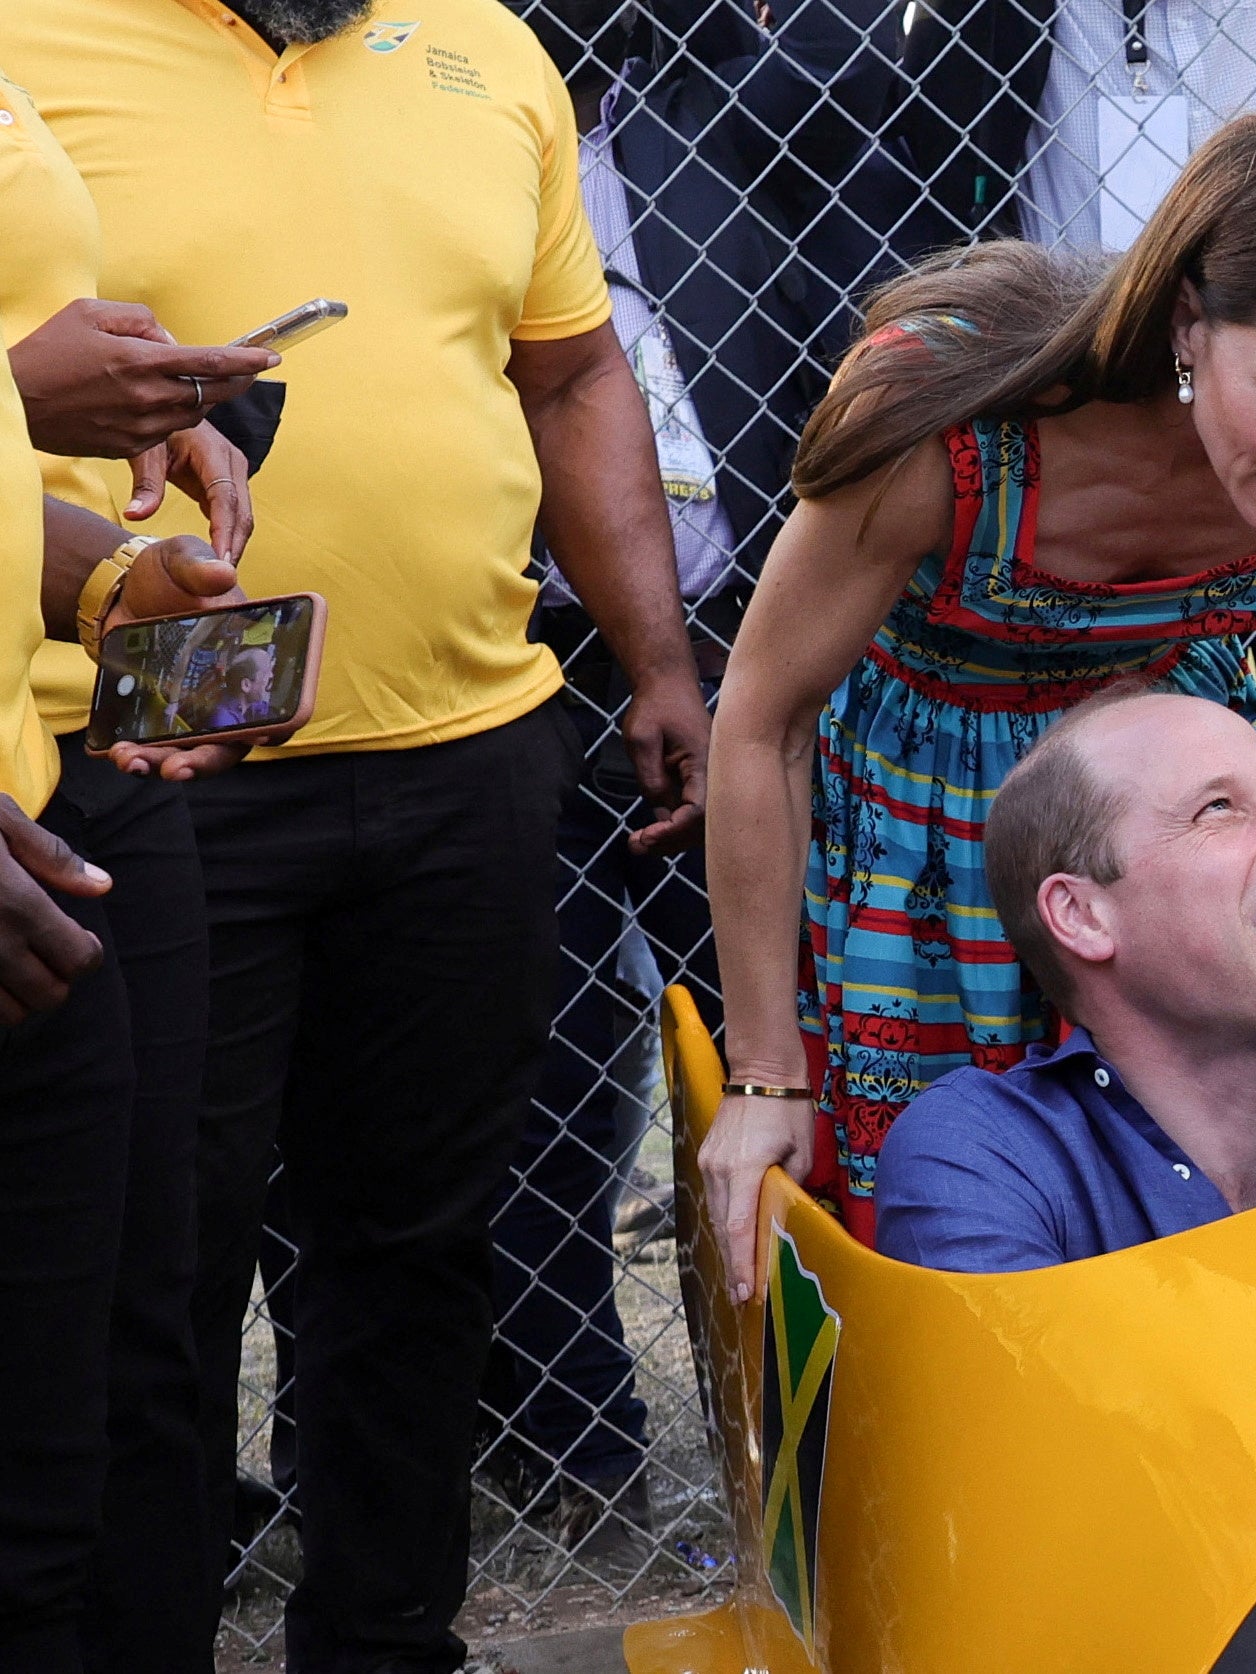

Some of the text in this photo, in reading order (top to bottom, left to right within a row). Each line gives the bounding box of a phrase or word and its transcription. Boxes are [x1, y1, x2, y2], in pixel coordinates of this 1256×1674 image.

[426, 44, 469, 64] Jamaica
[426, 56, 481, 78] Bobsleigh
[431, 81, 492, 100] Federation
[440, 71, 486, 91] Skeleton
